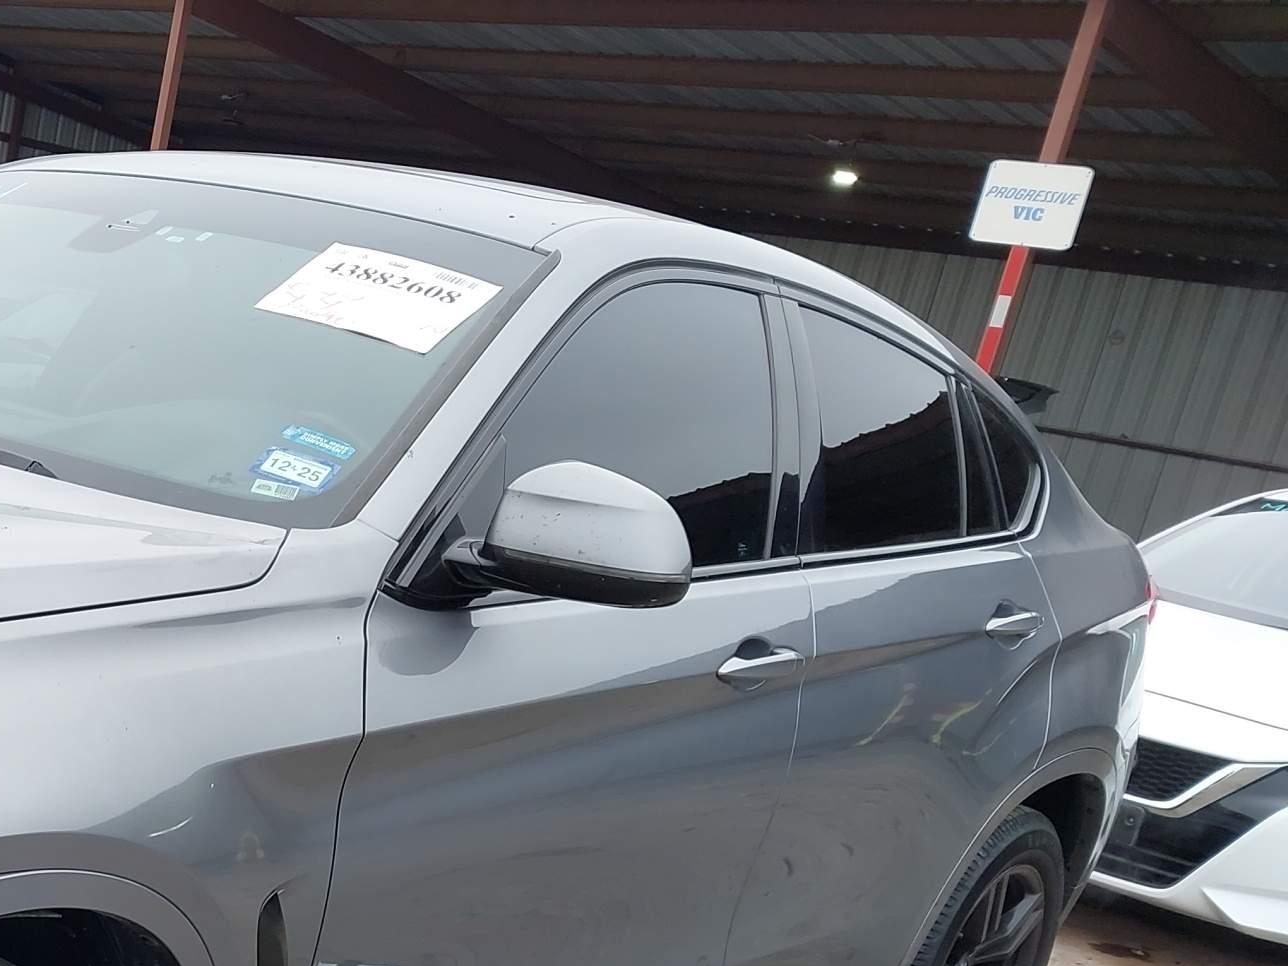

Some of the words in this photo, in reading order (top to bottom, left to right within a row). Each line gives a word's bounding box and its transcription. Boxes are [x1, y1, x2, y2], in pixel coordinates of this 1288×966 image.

[985, 185, 1081, 206] PROGRESSIVE
[1013, 205, 1046, 222] VIC
[325, 261, 462, 304] 43882608
